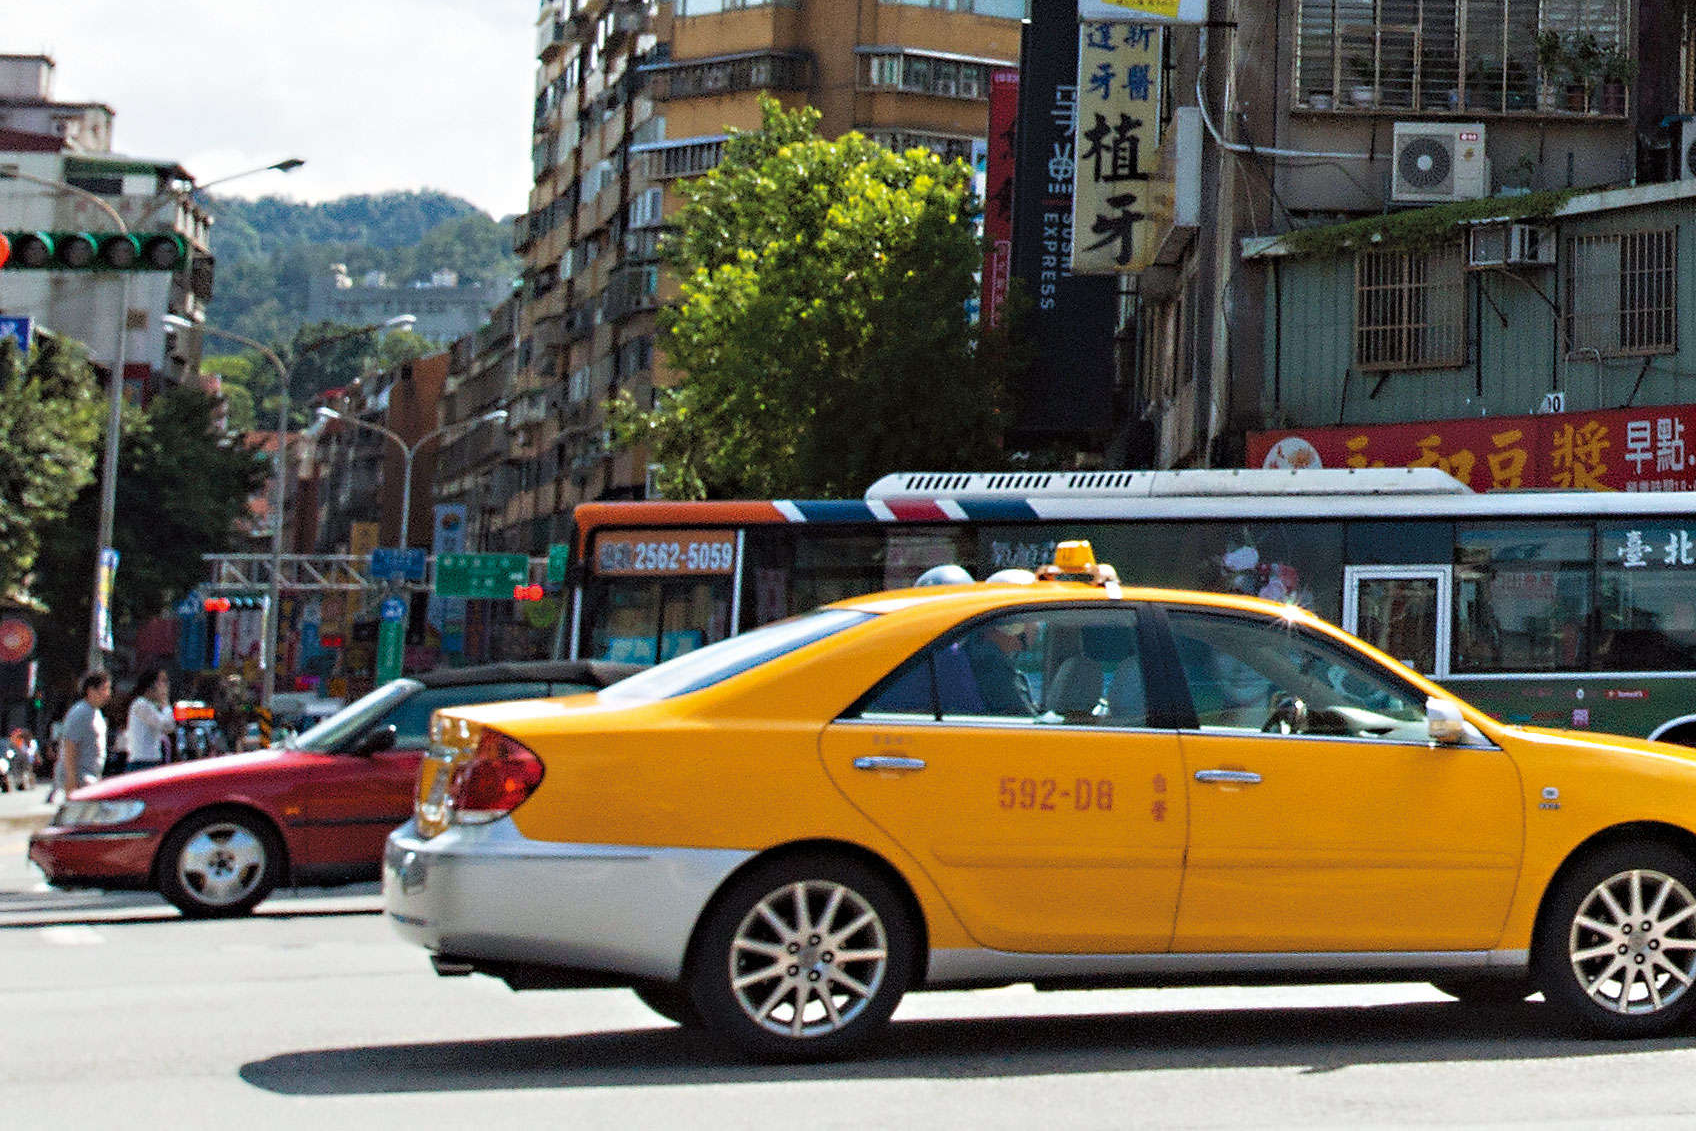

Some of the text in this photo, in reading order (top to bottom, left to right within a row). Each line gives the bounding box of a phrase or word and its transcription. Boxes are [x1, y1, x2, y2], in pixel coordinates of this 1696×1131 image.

[1081, 112, 1149, 266] 植牙
[1040, 213, 1059, 310] EXPRESS
[1617, 530, 1695, 568] 臺北
